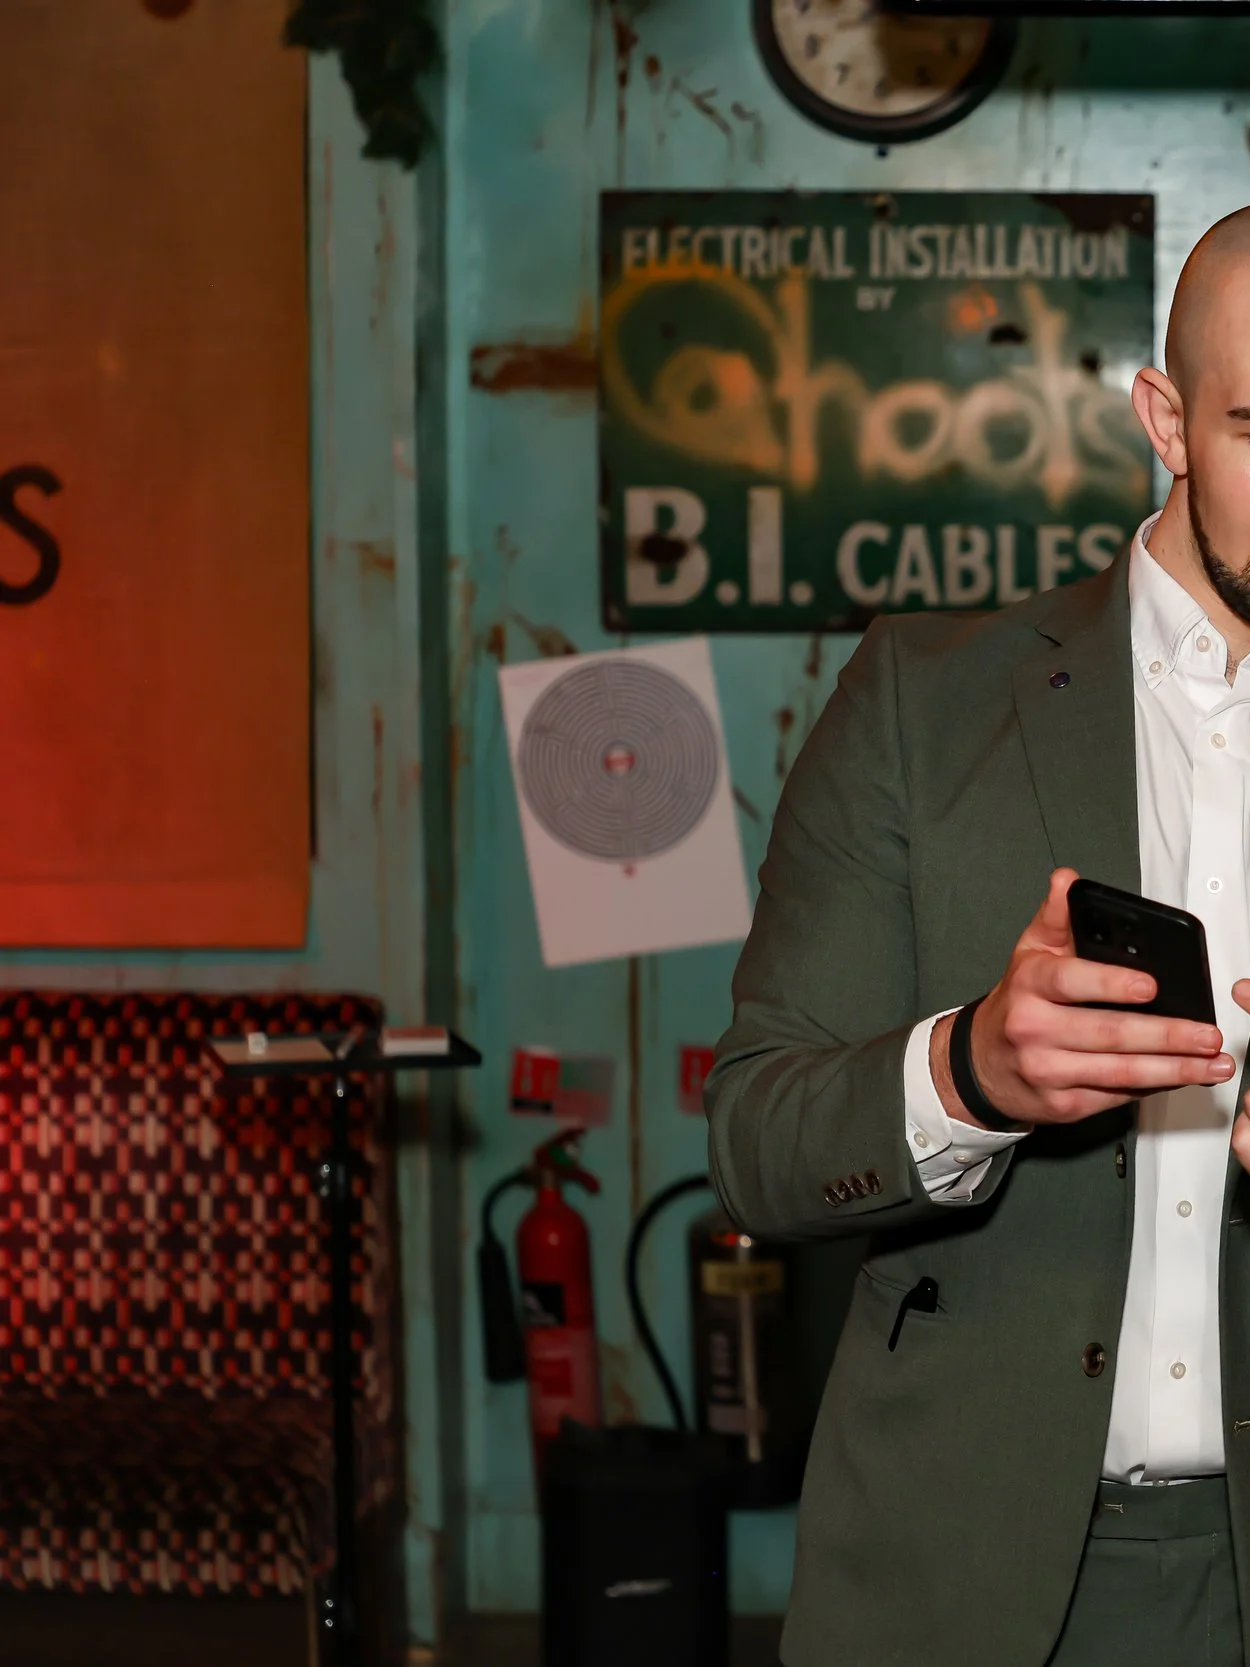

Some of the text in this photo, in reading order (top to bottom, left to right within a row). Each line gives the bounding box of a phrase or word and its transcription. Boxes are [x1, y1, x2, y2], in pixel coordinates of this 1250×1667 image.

[622, 222, 1129, 279] ELECTRICAL INSTALLATION
[857, 285, 897, 312] BY
[624, 485, 1126, 607] B.I. CABLES
